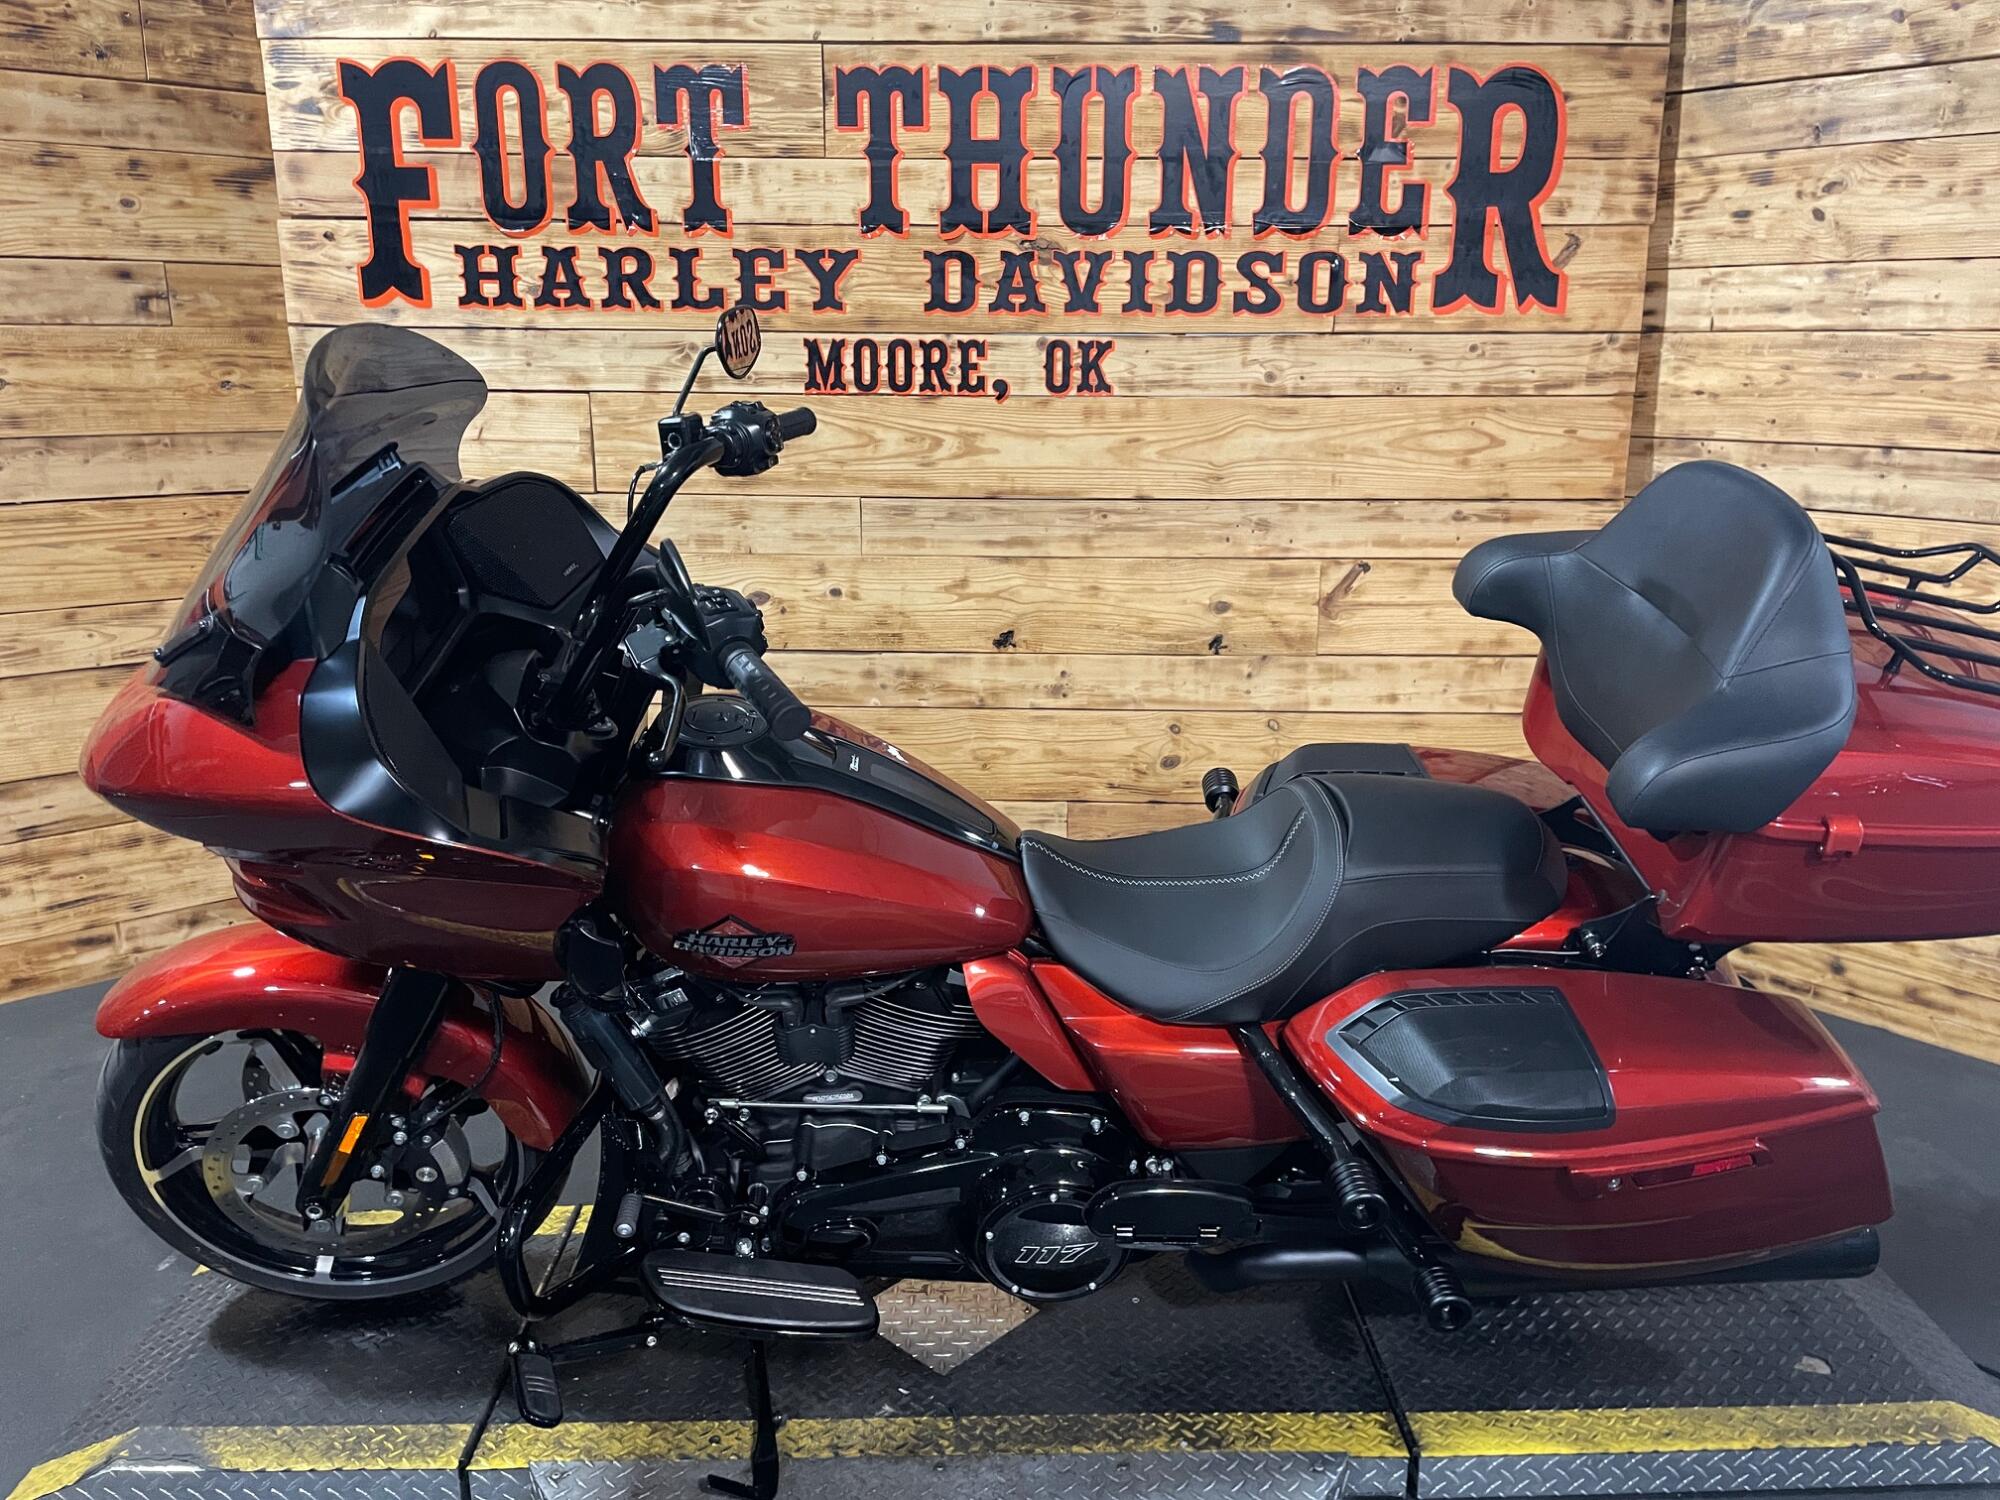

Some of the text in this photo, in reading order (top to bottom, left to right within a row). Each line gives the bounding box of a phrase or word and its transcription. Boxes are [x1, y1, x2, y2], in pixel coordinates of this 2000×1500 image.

[337, 56, 1568, 316] FORT THUNDER
[455, 244, 1425, 317] HARLEY DAVIDSON
[803, 337, 1114, 403] MOORE, OK
[673, 940, 796, 957] DAVIDSON
[1014, 1241, 1099, 1264] 117
